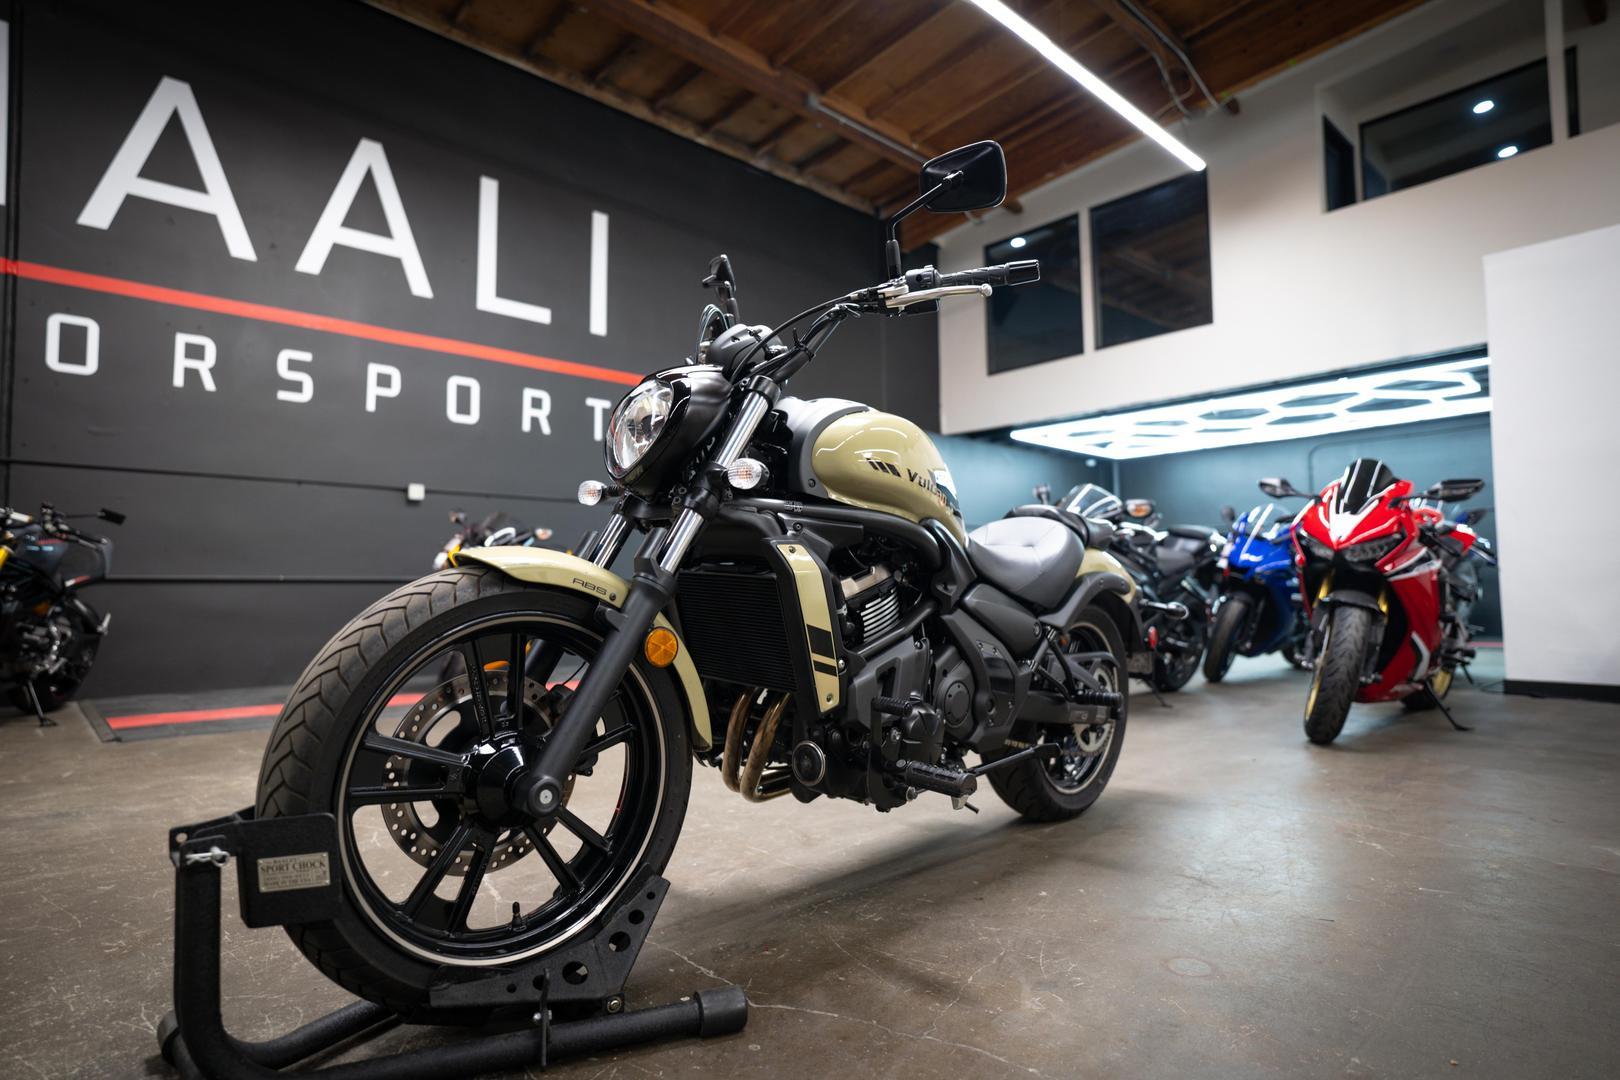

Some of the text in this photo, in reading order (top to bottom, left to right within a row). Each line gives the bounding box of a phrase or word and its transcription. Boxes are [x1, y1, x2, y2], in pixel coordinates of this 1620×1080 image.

[0, 19, 609, 337] AALI
[572, 577, 607, 595] ABS
[260, 863, 289, 873] SPORT
